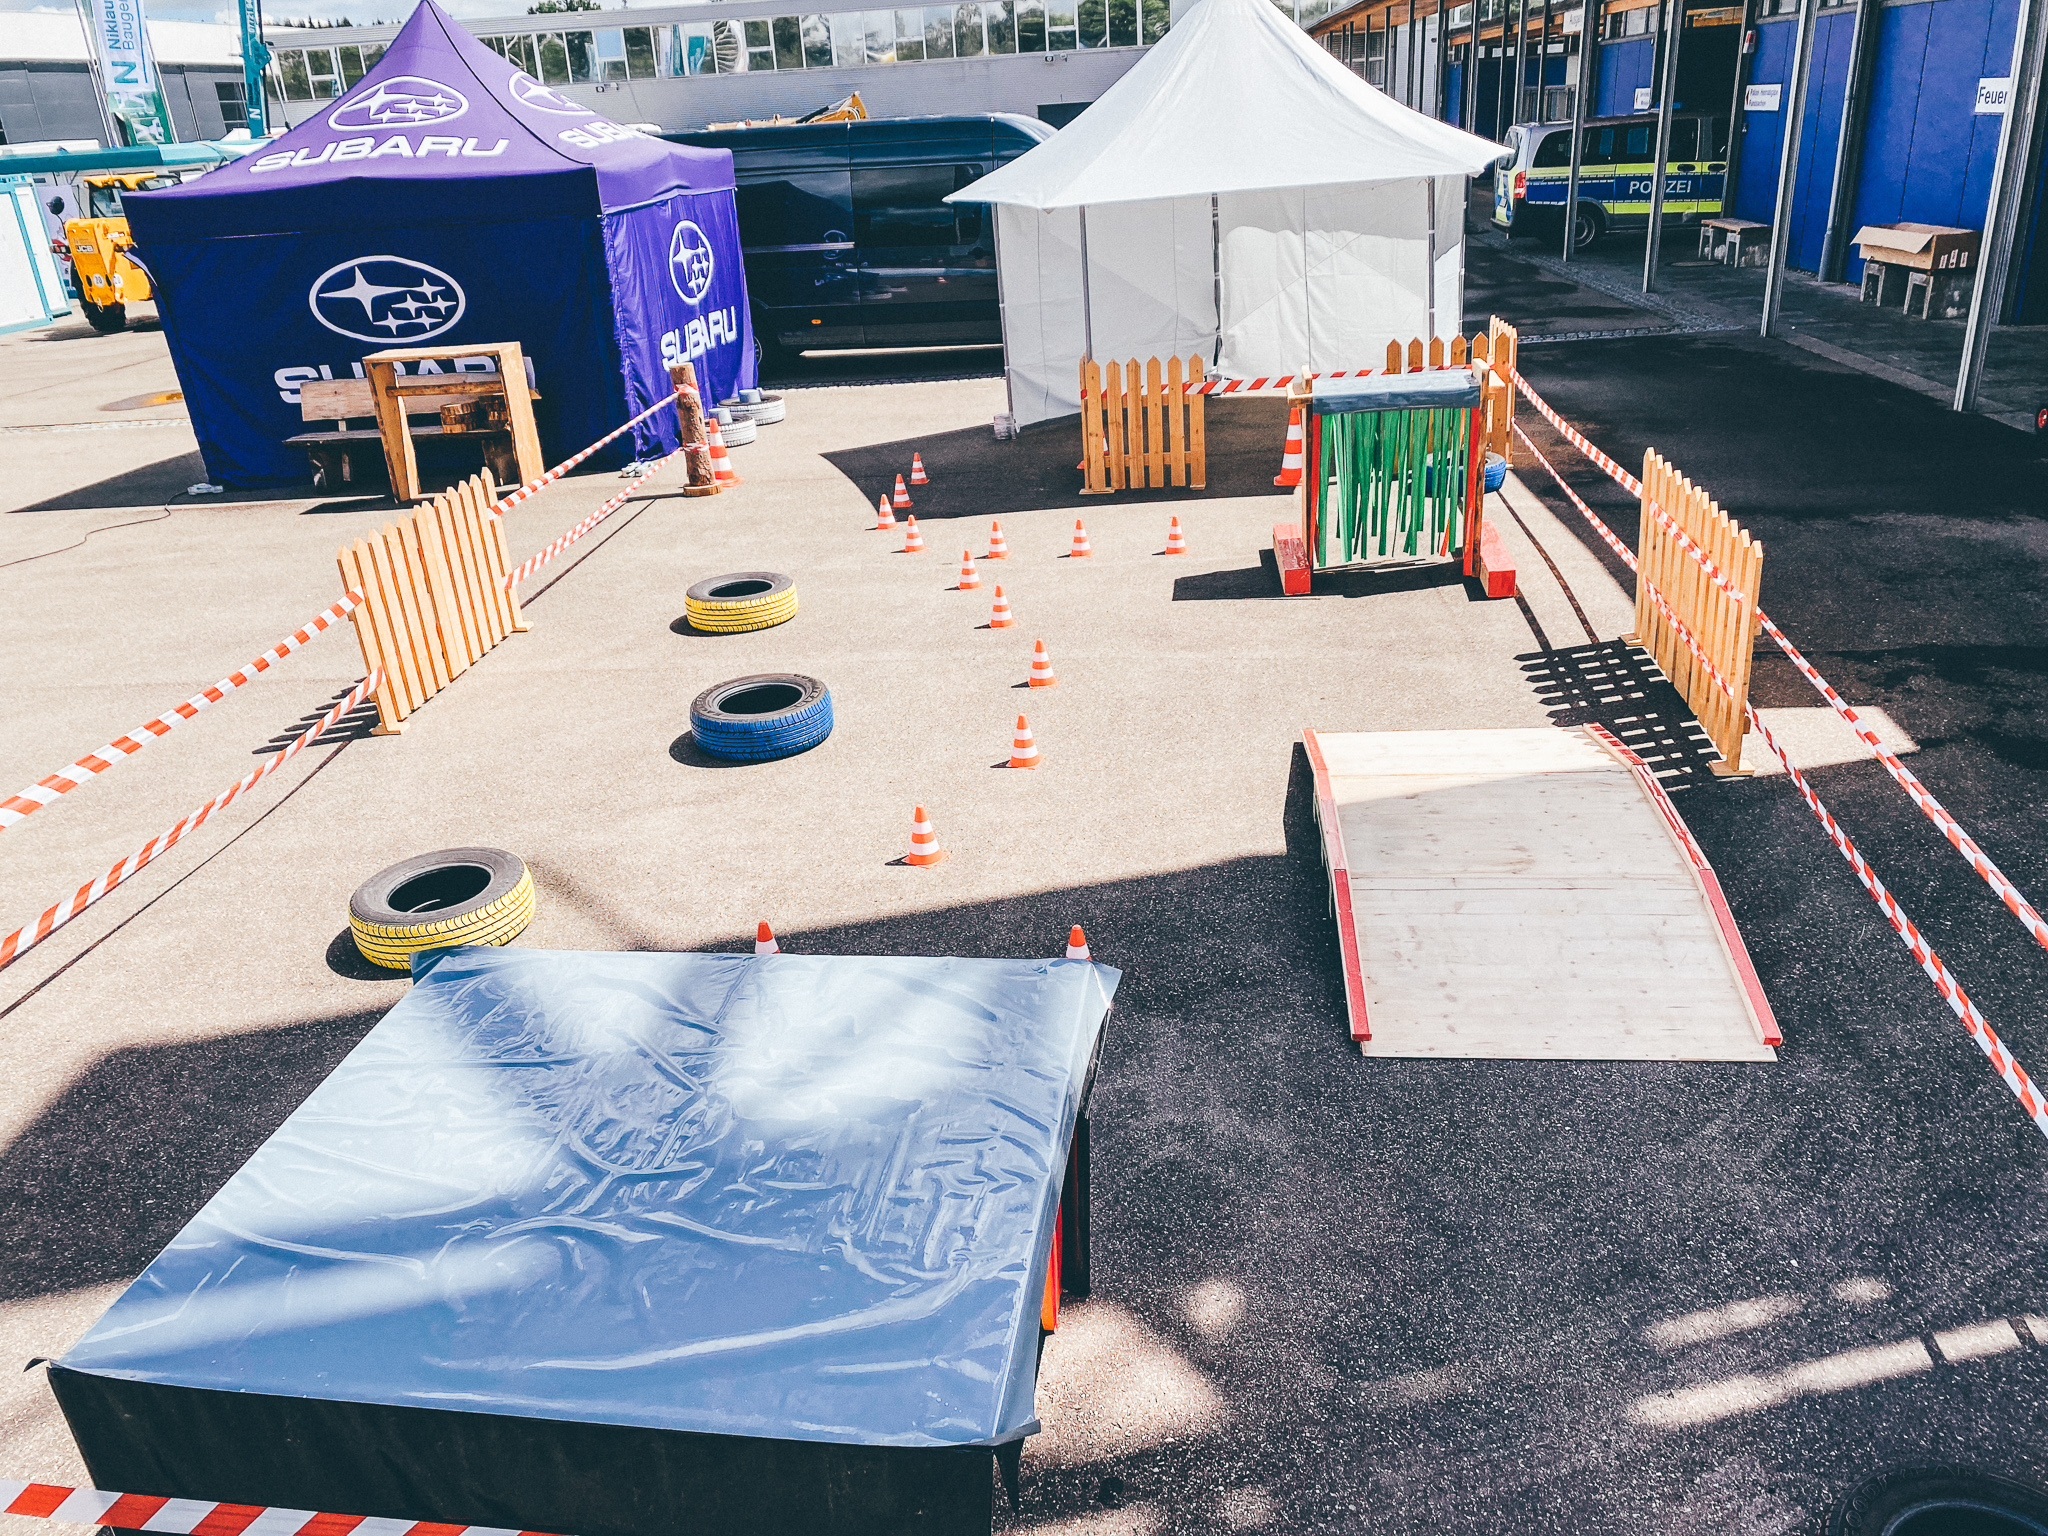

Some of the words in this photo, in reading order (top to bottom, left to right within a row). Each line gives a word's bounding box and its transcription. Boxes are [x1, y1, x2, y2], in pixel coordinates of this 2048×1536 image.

[119, 0, 135, 50] Bauge
[248, 135, 510, 173] SUBARU
[1629, 180, 1692, 195] POZEI
[660, 305, 738, 372] SUBARU
